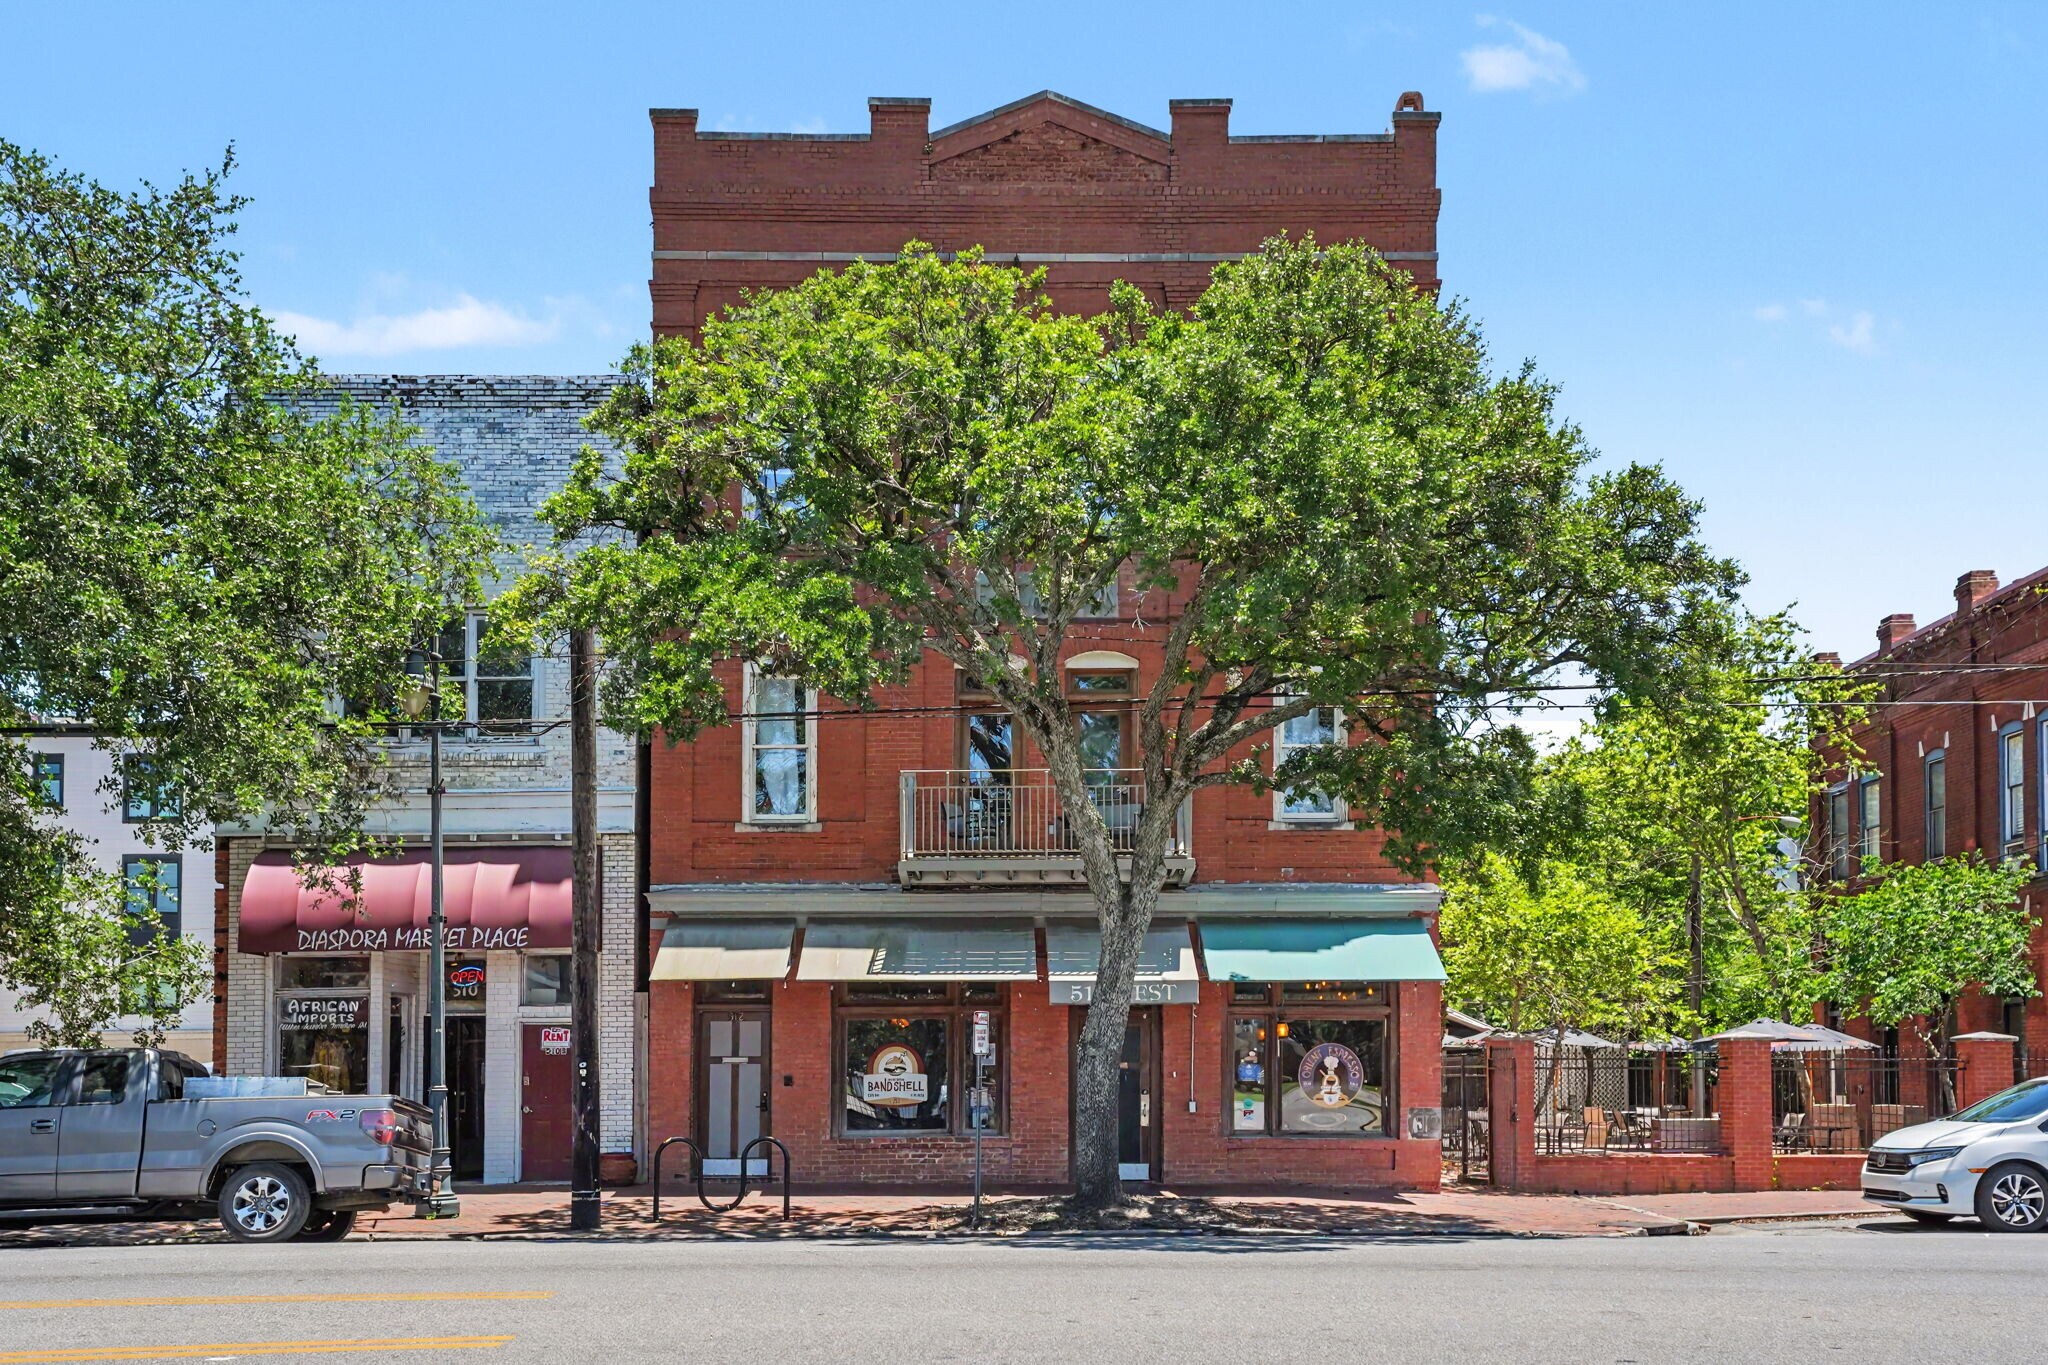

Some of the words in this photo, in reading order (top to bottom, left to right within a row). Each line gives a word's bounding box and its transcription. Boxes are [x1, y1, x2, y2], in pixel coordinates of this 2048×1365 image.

[297, 928, 388, 951] DIASPORA
[471, 927, 529, 949] PLACE
[450, 970, 484, 983] OPEN
[1133, 984, 1178, 1001] EST
[288, 999, 359, 1014] AFRICAN
[292, 1011, 355, 1024] IMPORTS
[867, 1077, 925, 1092] BANDSHELL
[305, 1108, 357, 1122] FX2
